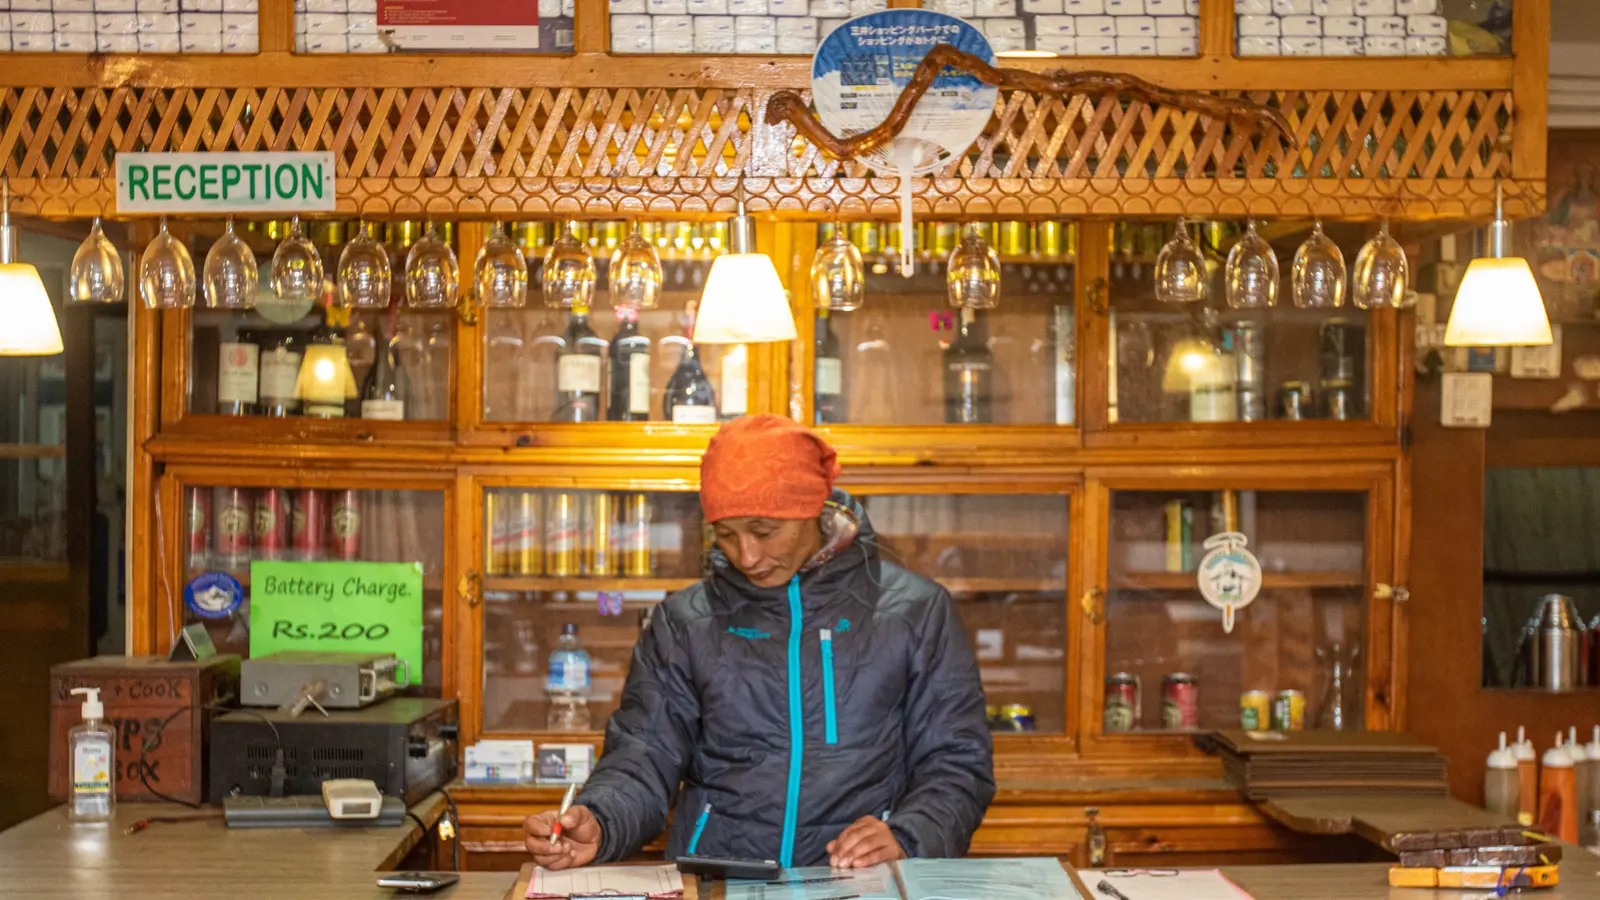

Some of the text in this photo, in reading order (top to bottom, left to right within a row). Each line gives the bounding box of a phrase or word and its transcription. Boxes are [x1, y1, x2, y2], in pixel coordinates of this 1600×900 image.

[128, 163, 324, 201] RECEPTION
[264, 576, 335, 602] Battery
[342, 577, 412, 602] Charge.
[272, 619, 390, 641] Rs.200
